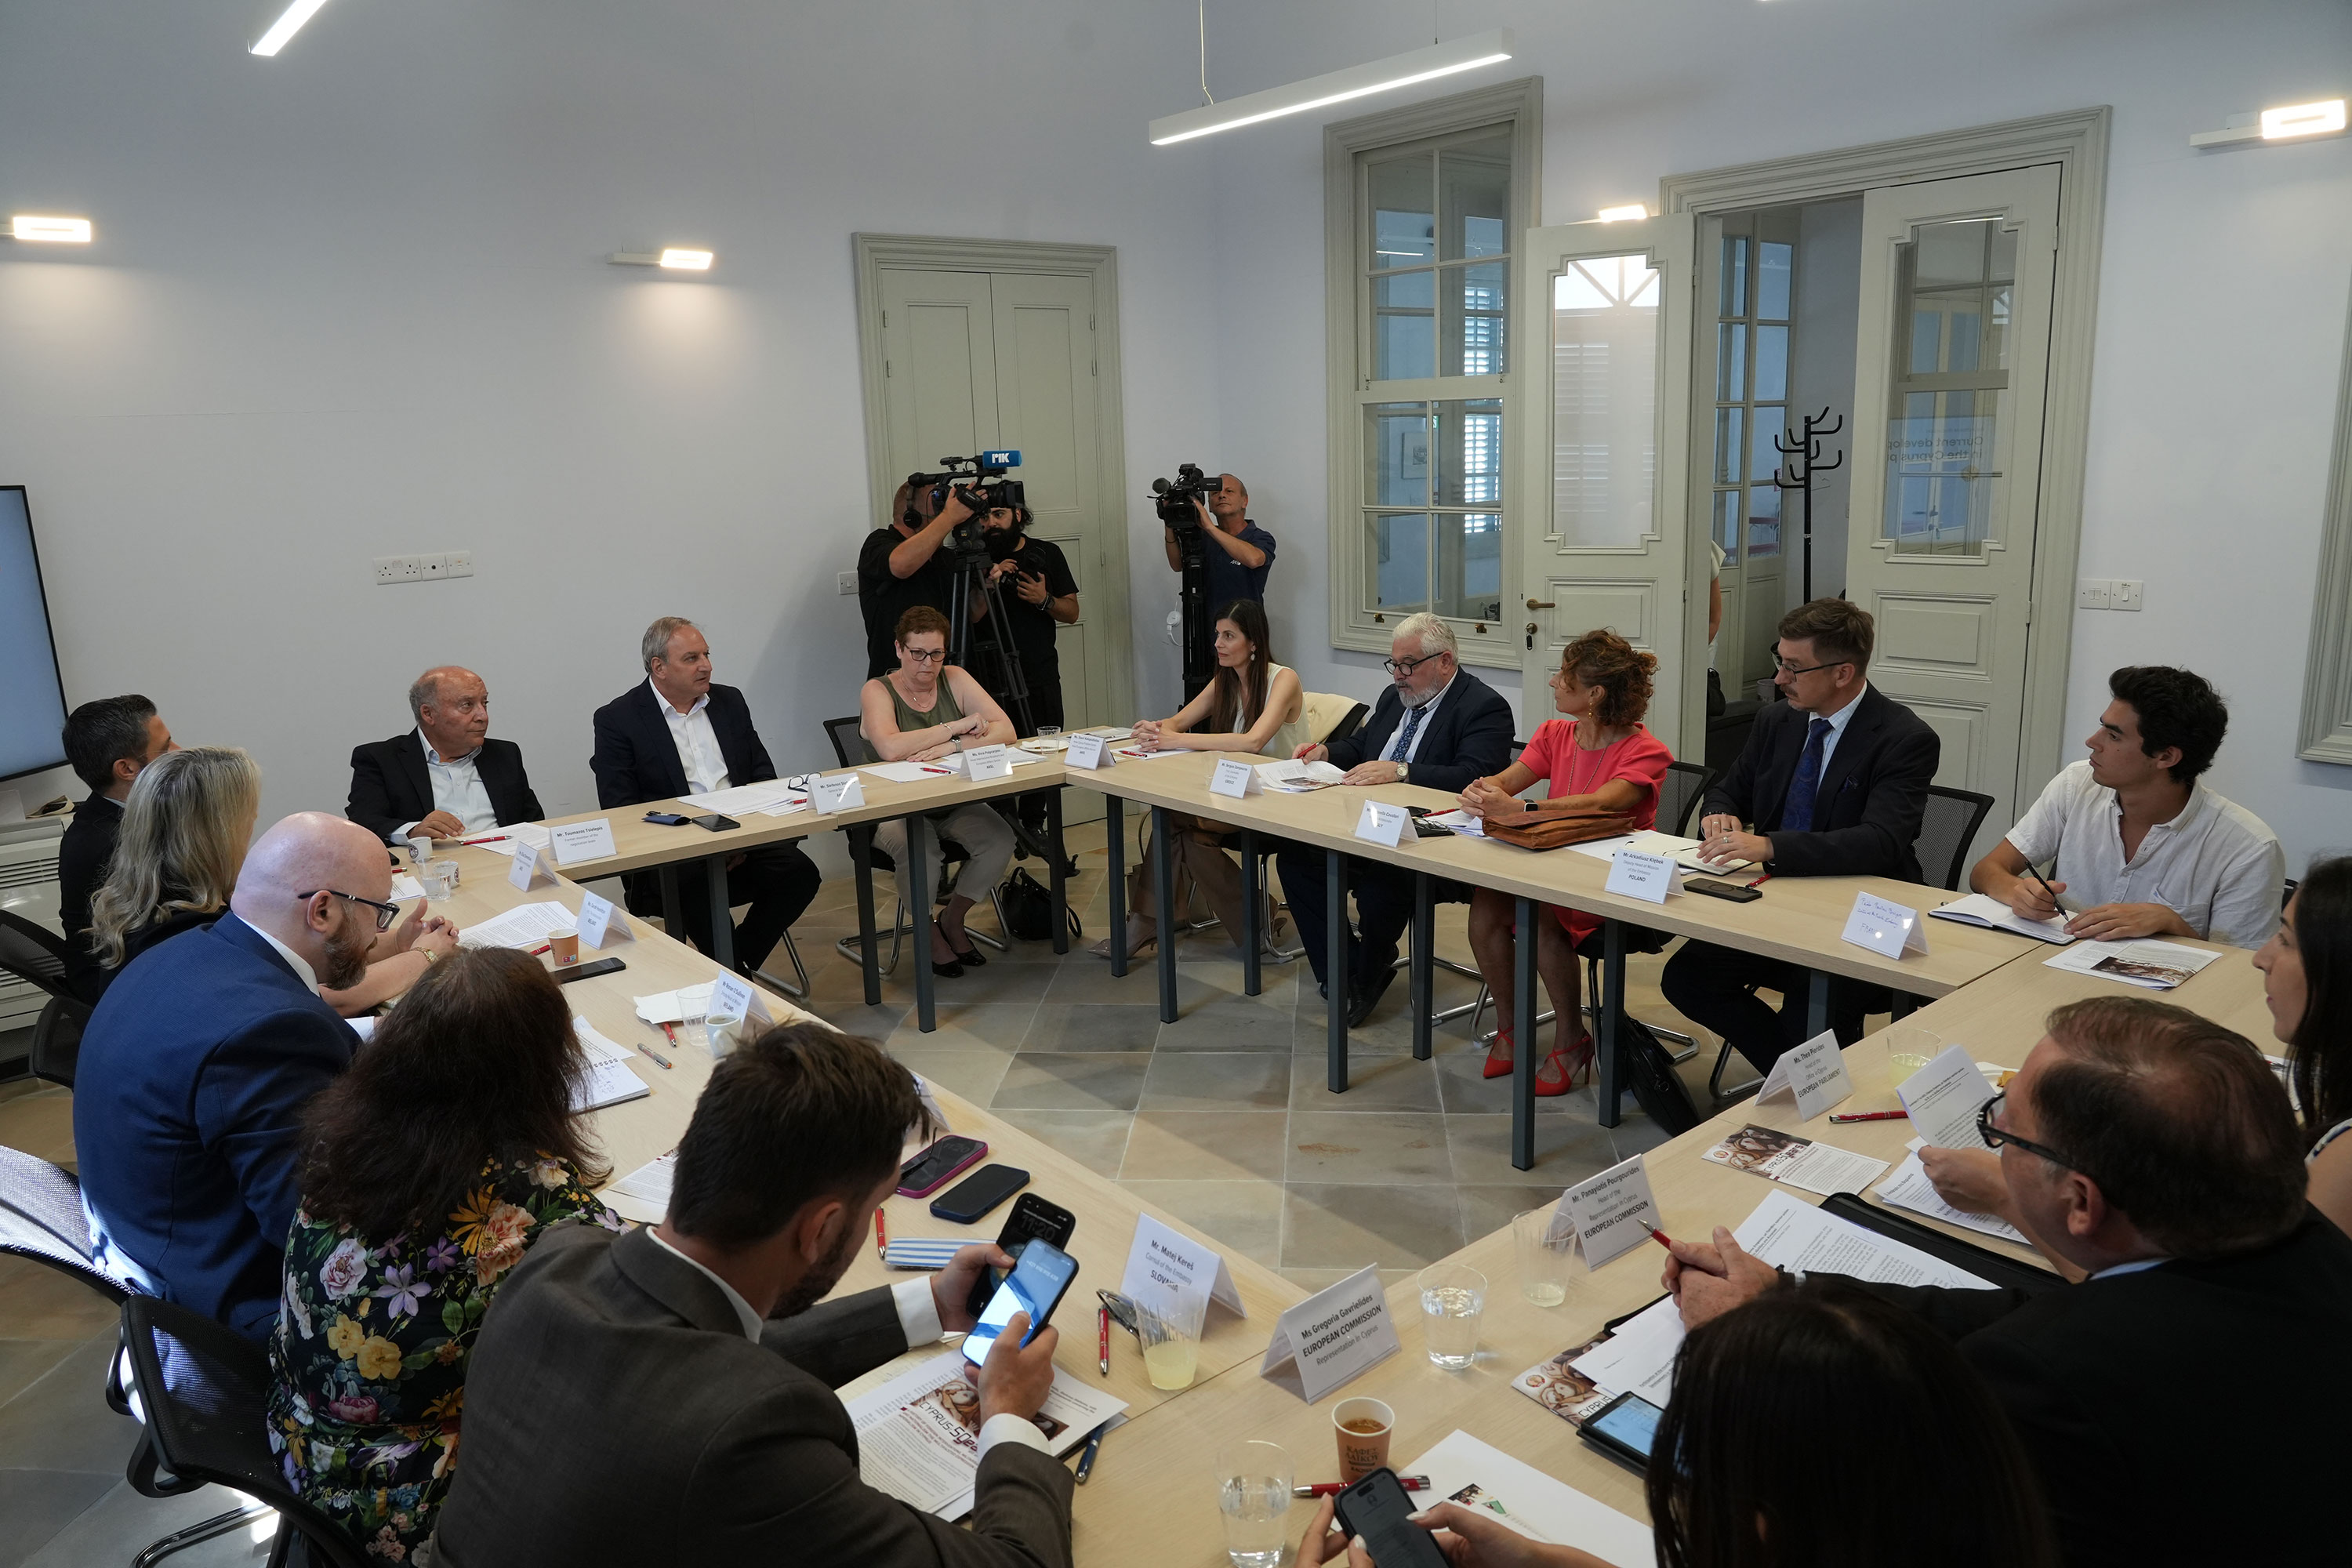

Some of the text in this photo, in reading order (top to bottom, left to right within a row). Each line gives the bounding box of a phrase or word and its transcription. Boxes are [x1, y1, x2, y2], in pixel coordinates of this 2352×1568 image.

[1793, 1056, 1802, 1065] Ms.
[1801, 1051, 1811, 1060] Thea
[1798, 1068, 1841, 1098] EUROPEAN PARLIAMENT
[1571, 1166, 1640, 1204] Mr. Panayiotis Pourgourides
[1598, 1194, 1609, 1203] Head
[1584, 1200, 1649, 1239] EUROPEAN COMMISSION
[1588, 1203, 1619, 1221] Representation
[1623, 1193, 1638, 1204] Cyprus
[1151, 1240, 1194, 1271] Mr. Matej Kereš
[1172, 1269, 1192, 1286] Embassy
[1301, 1294, 1374, 1340] Ms Gregoria Gavrielides
[1302, 1305, 1381, 1357] EUROPEAN COMMISSION
[1316, 1324, 1379, 1366] Representation in Cyprus
